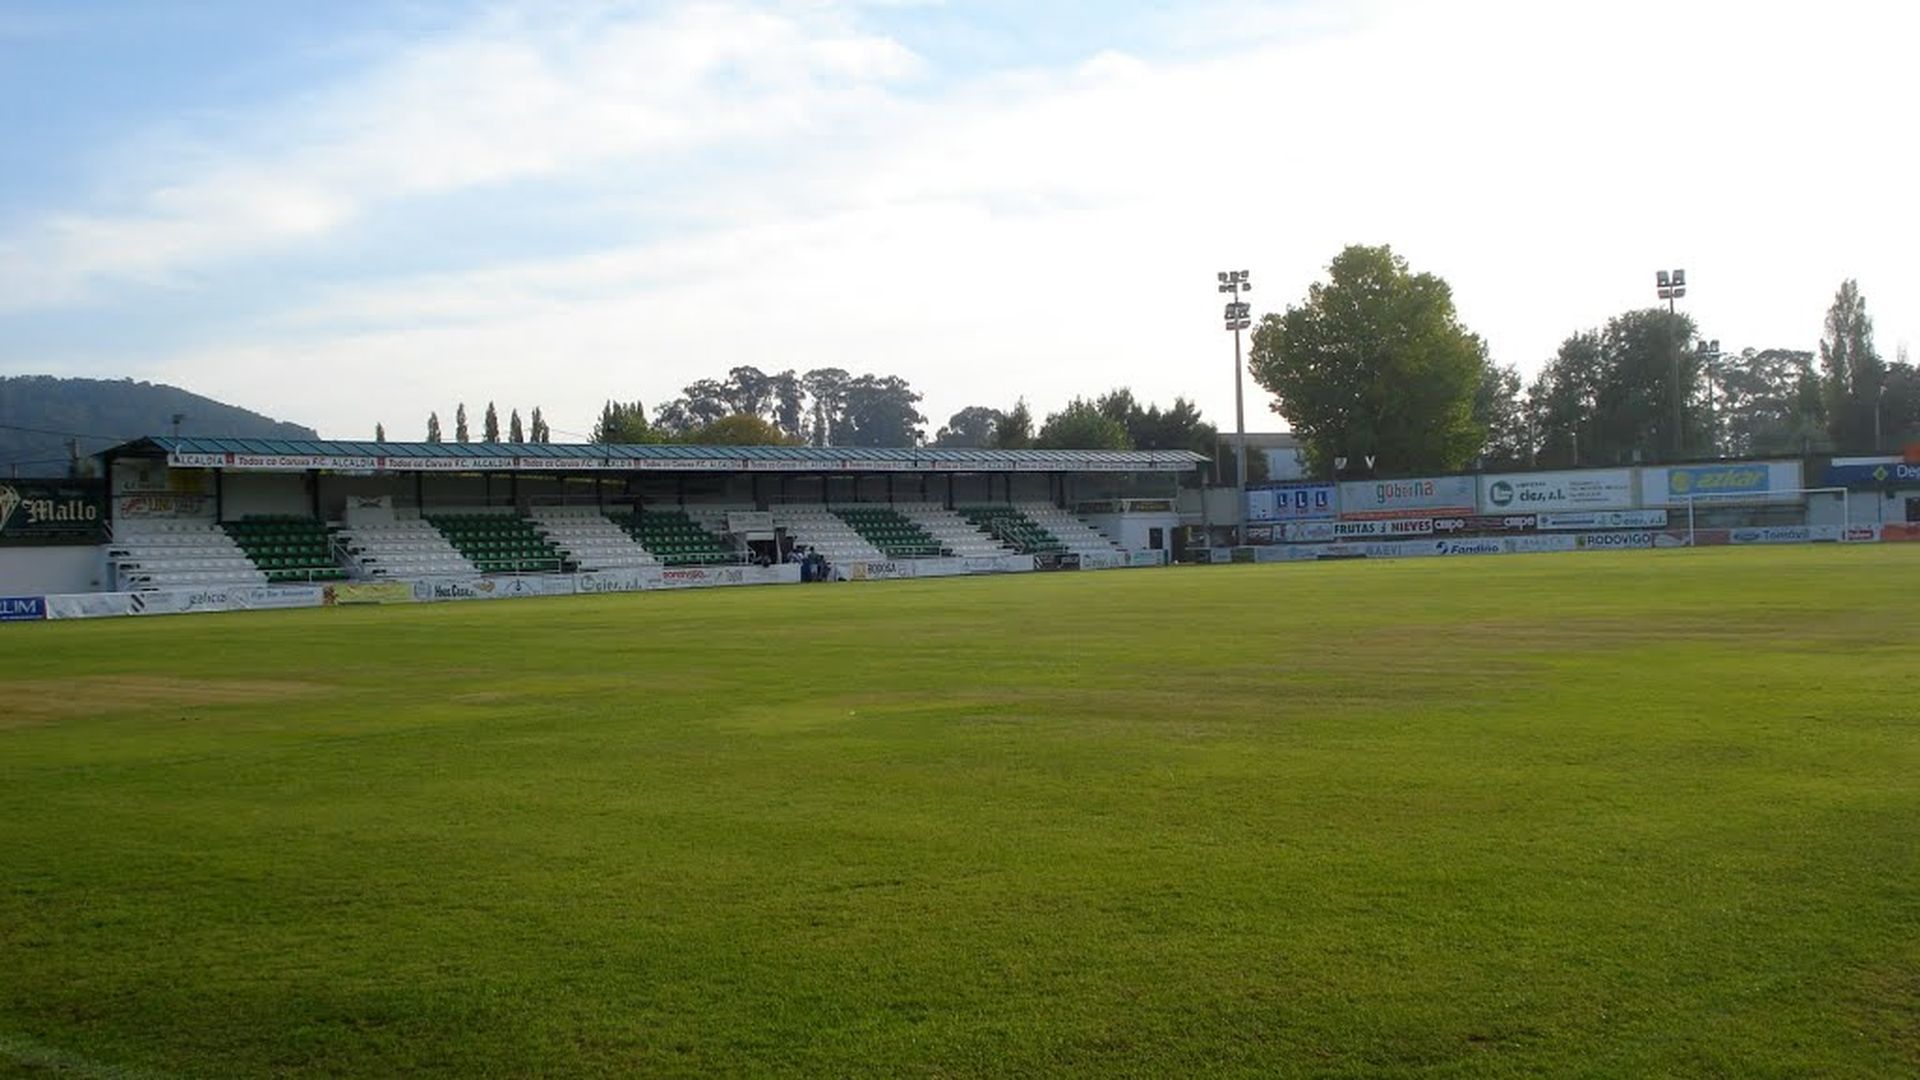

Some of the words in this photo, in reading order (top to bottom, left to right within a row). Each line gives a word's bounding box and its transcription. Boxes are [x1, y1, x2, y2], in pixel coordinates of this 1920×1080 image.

[1377, 481, 1434, 504] goberna
[22, 500, 97, 523] Mallo
[1334, 522, 1375, 535] FRUTAS
[1391, 518, 1432, 532] NIEVES
